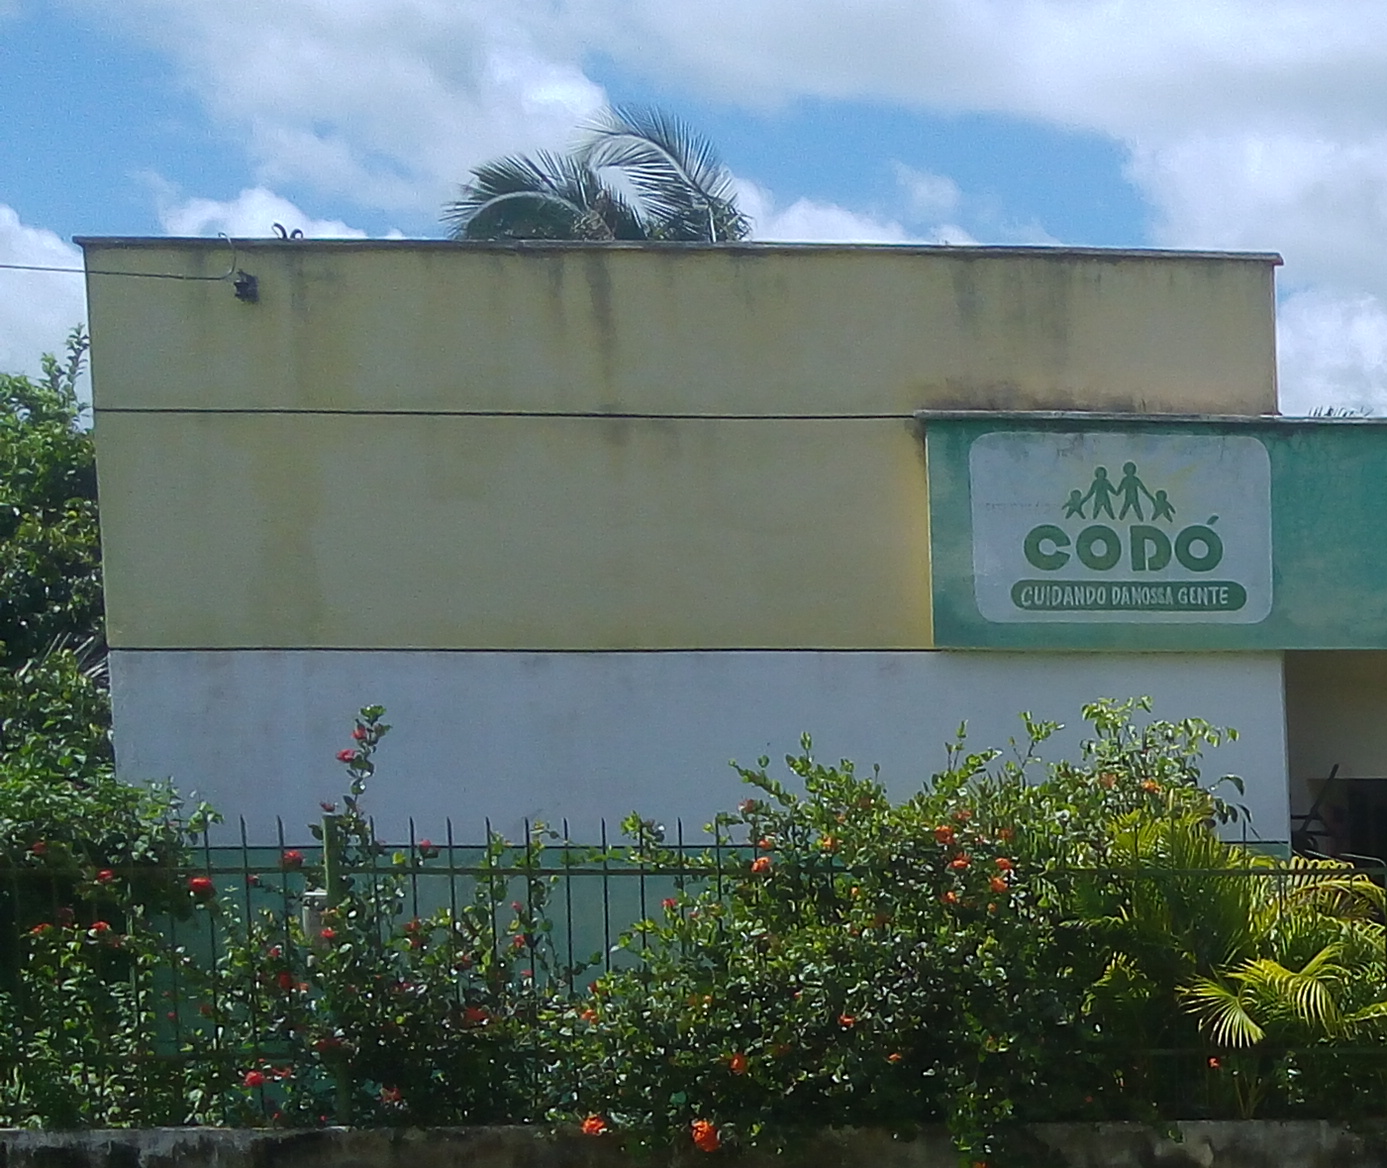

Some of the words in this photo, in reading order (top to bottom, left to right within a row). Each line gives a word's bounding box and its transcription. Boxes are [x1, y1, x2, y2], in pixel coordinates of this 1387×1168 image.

[1023, 514, 1224, 572] CODÓ
[1021, 586, 1107, 607] CUIDANDO
[1178, 586, 1229, 606] GENTE
